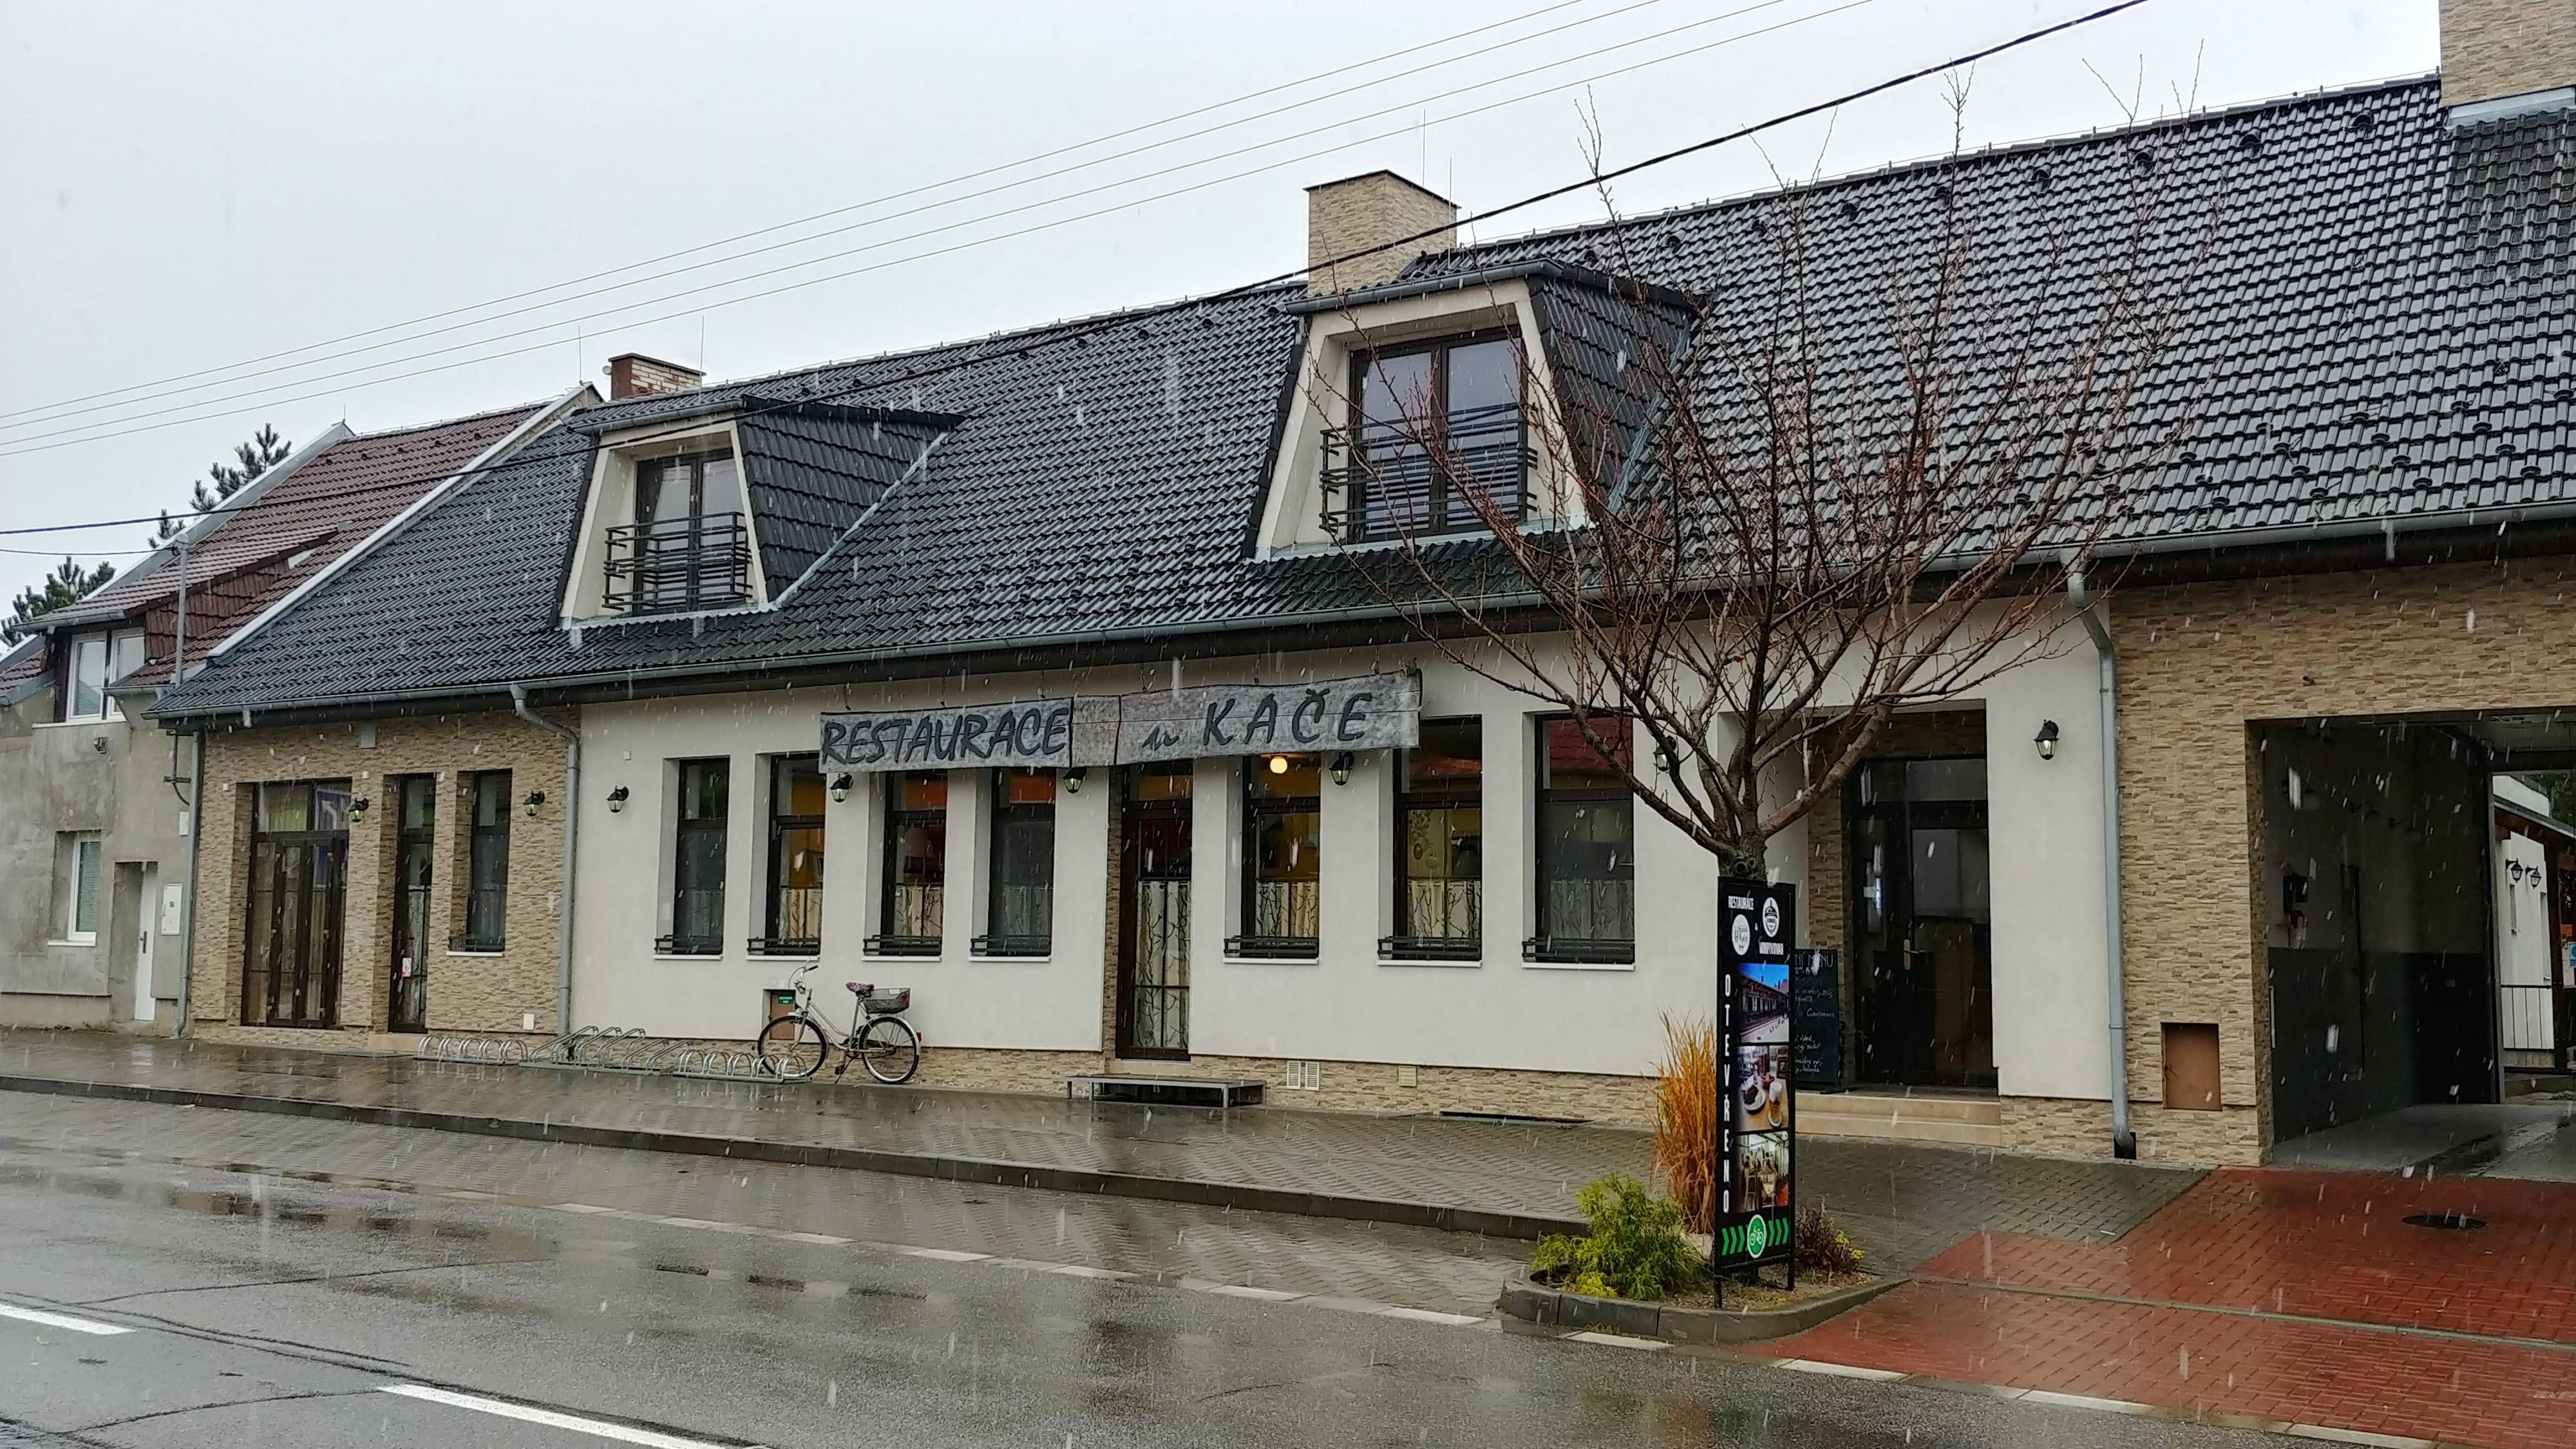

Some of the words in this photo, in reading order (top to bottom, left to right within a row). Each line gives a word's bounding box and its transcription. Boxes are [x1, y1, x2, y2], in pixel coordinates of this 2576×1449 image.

[822, 708, 1070, 766] RESTAURACE
[1202, 688, 1373, 746] KAČE
[1808, 954, 1833, 967] MNU
[1723, 974, 1731, 1213] OTEVŘENO
